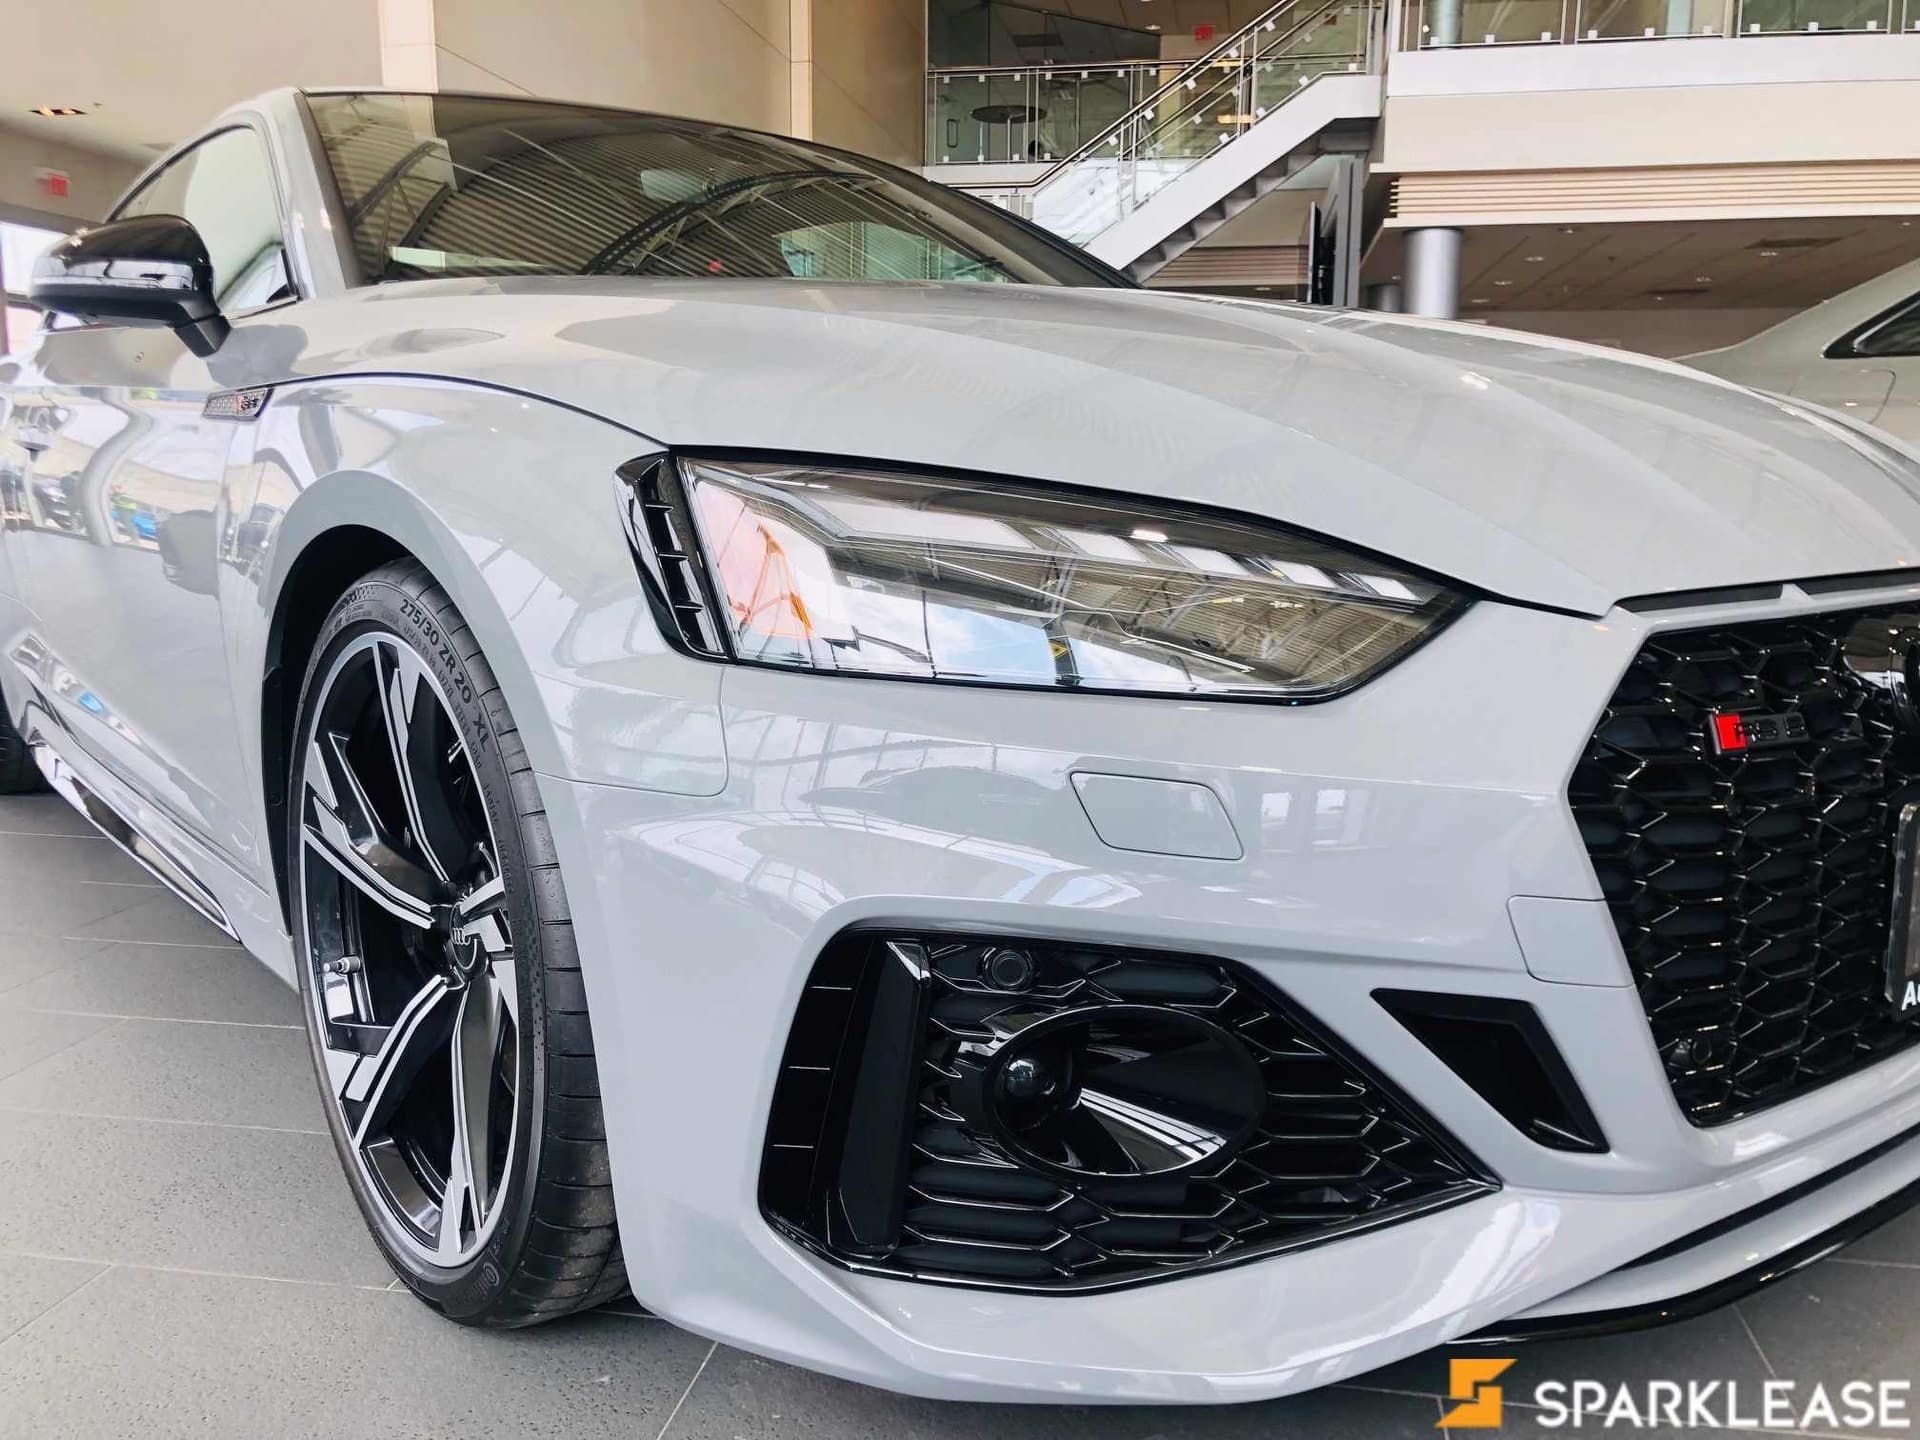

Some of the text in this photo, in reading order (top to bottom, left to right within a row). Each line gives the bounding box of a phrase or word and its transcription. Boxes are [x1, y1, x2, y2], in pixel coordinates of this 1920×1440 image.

[399, 598, 440, 647] 275/30
[438, 643, 456, 675] ZR
[453, 671, 472, 705] 20
[472, 713, 491, 753] XL
